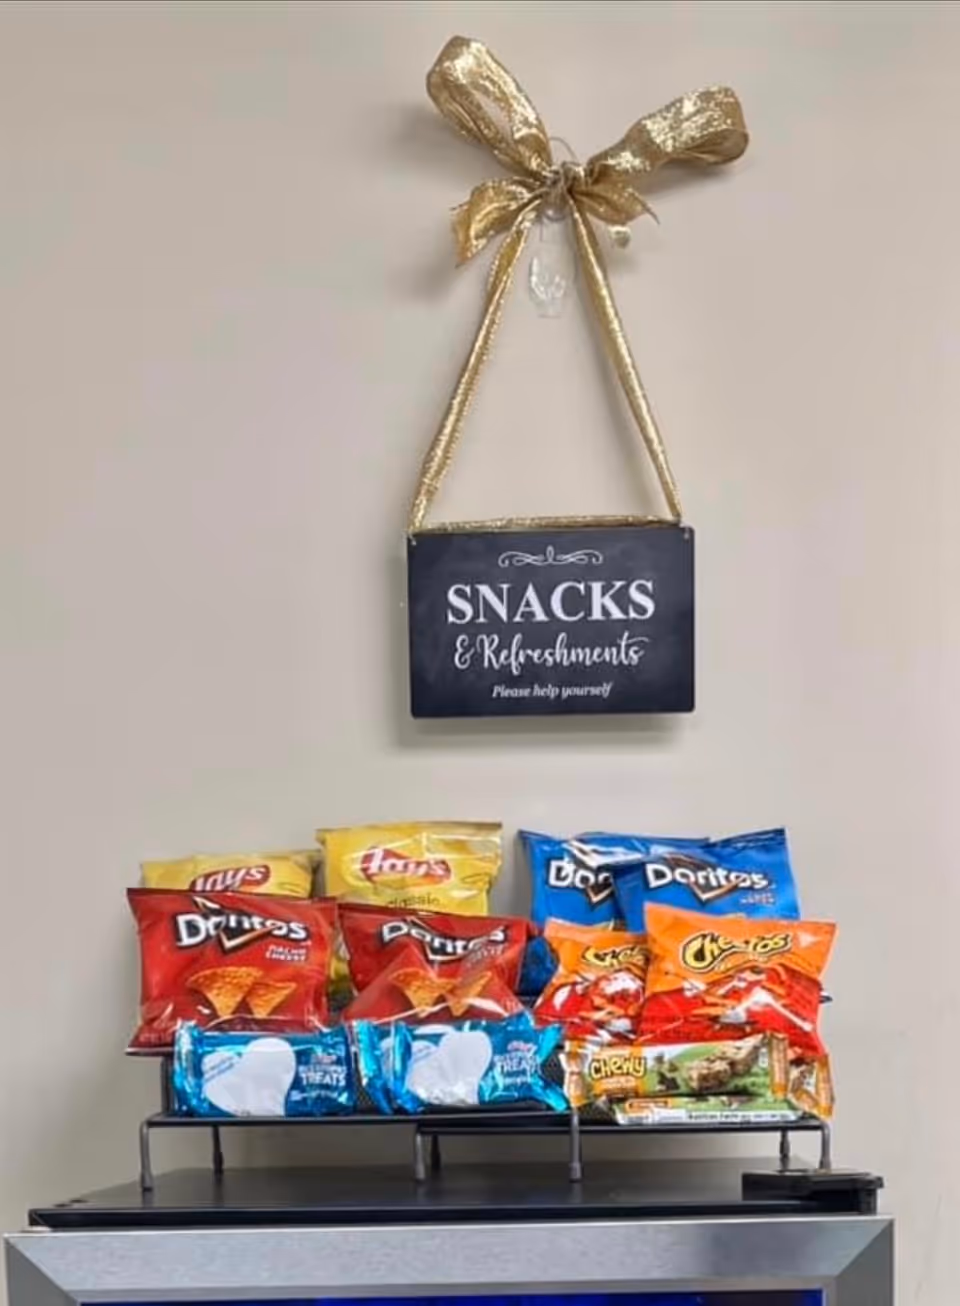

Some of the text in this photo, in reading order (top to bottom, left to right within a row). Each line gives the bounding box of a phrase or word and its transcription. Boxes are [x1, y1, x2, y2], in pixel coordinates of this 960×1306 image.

[446, 579, 655, 624] SNACKS
[454, 631, 650, 676] & Refreshments
[492, 682, 613, 699] Please help yourself
[646, 862, 769, 890] Doritos
